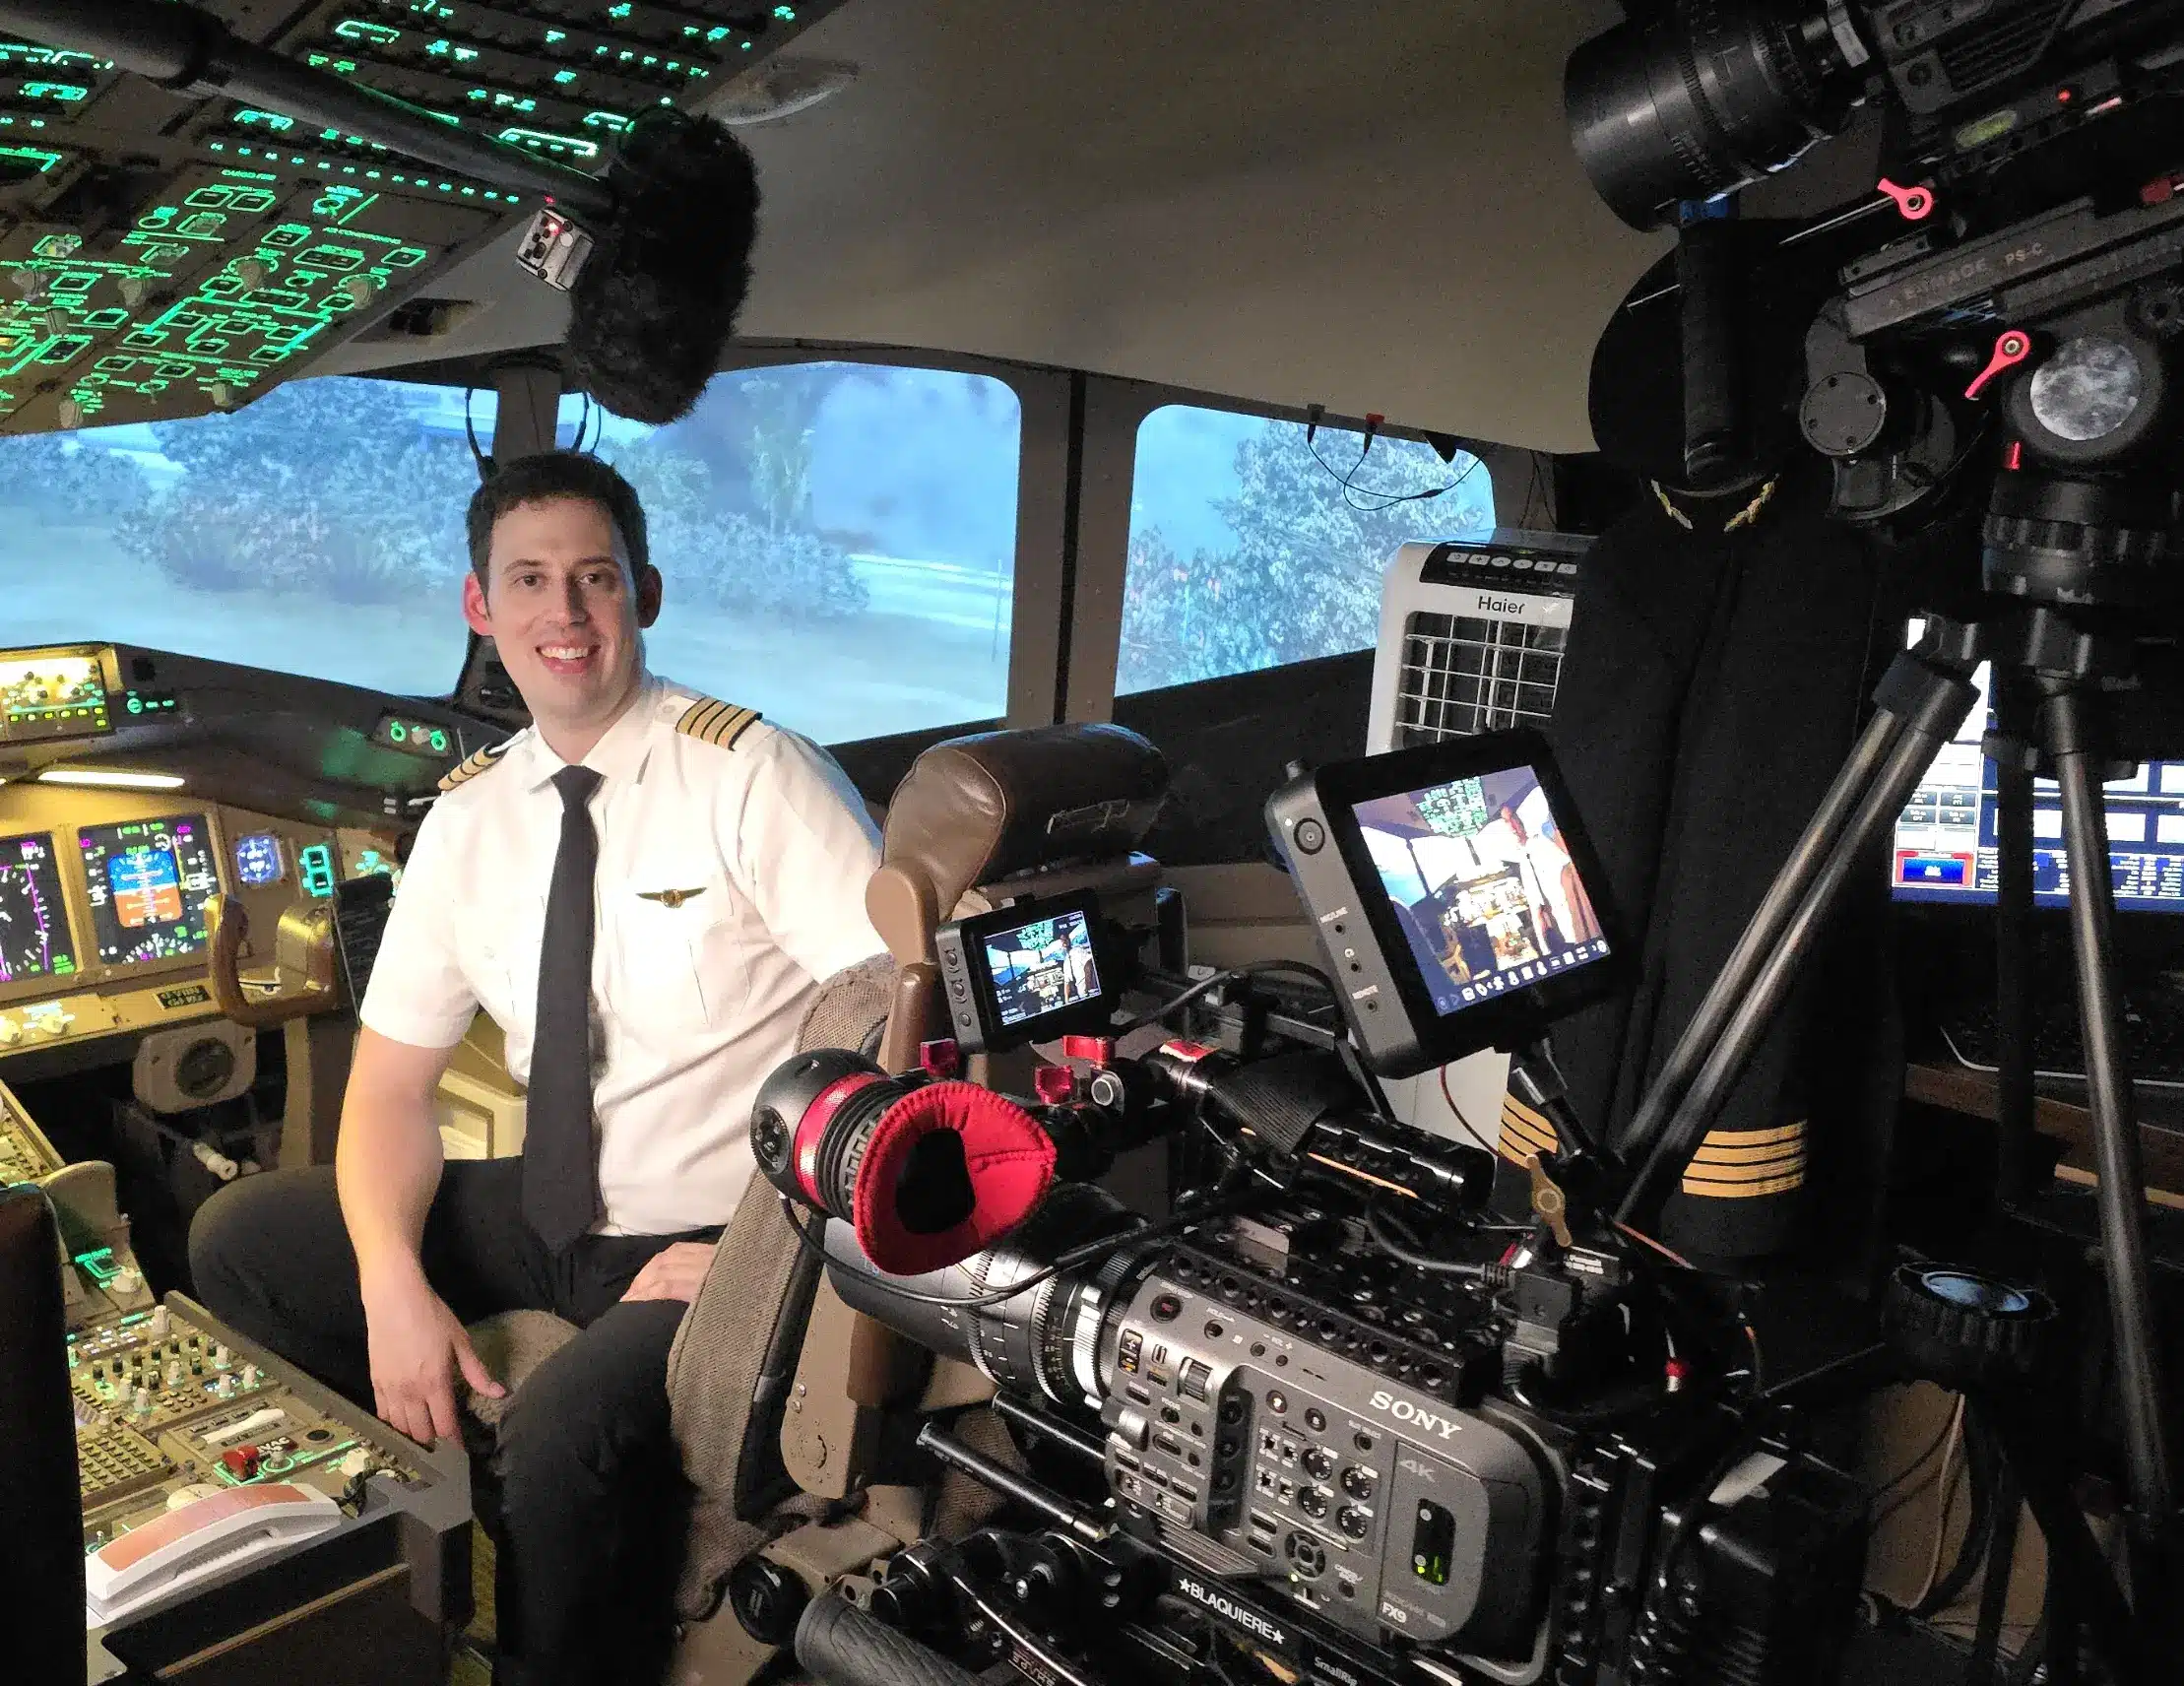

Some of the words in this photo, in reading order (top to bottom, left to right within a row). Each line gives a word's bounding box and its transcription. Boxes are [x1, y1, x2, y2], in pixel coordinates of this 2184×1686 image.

[1478, 595, 1525, 615] Haier
[1369, 1391, 1462, 1440] SONY
[1400, 1459, 1436, 1483] 4K
[1190, 1582, 1275, 1640] BLAQUIERE
[1381, 1601, 1407, 1624] FX9
[1315, 1656, 1358, 1686] SmallRig
